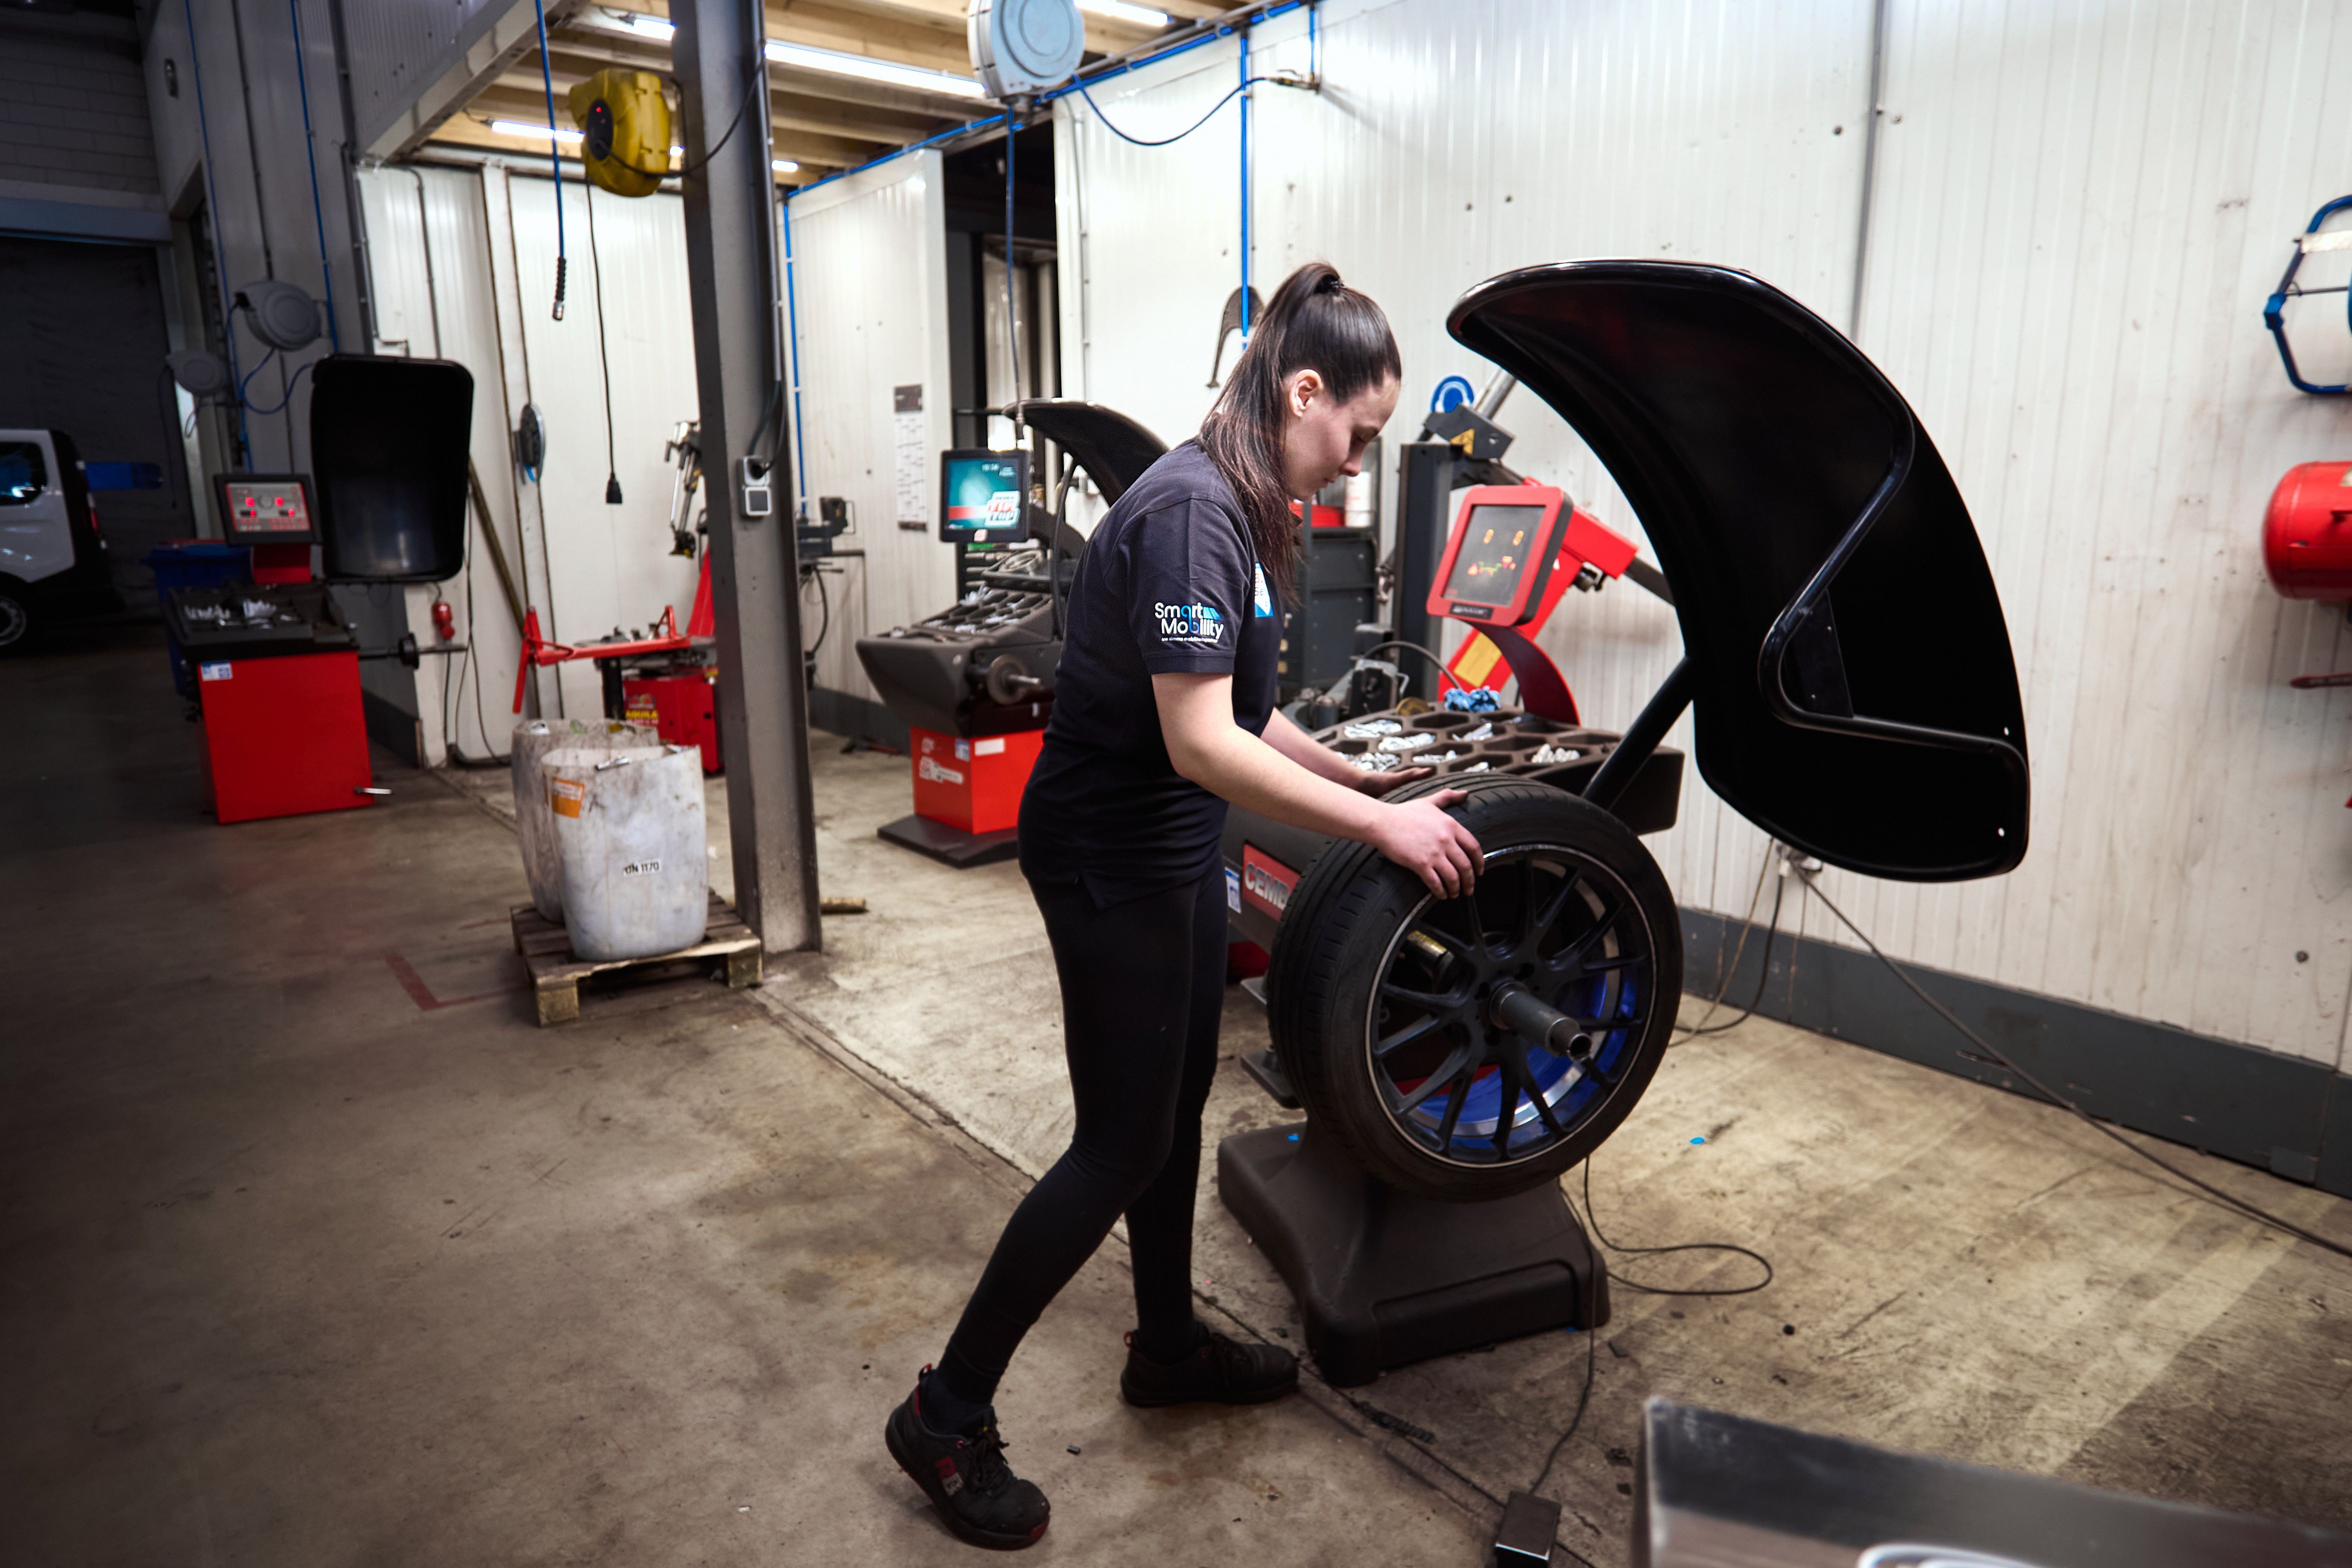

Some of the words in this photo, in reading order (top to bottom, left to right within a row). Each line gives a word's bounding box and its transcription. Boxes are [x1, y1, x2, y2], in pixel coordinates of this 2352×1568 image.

[1155, 602, 1203, 619] Smart
[1161, 618, 1224, 639] Mobility
[641, 862, 659, 872] 1170
[1245, 862, 1290, 911] CEMB
